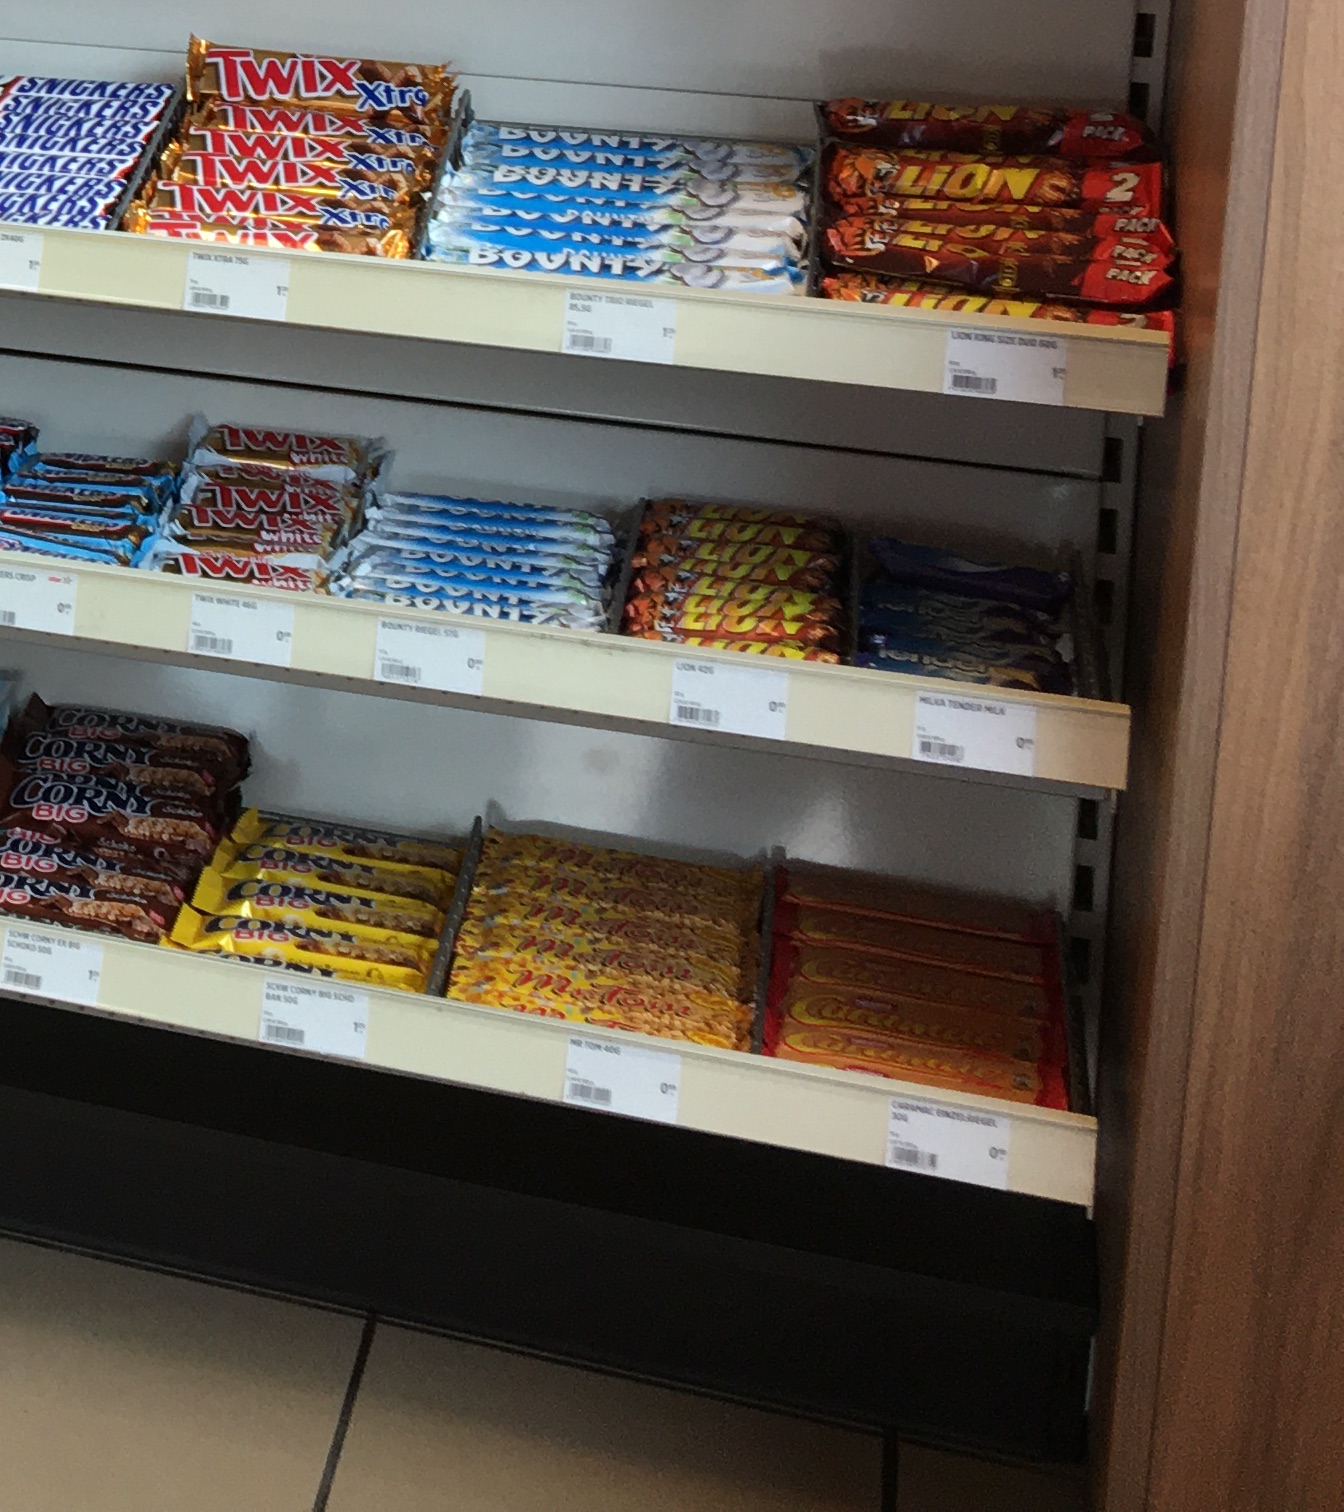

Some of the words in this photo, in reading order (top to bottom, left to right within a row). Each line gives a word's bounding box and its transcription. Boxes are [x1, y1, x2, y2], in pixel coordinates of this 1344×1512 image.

[18, 76, 173, 101] SNICKERS
[206, 47, 363, 101] TWIX
[189, 128, 352, 161] TWIX
[894, 161, 1041, 201] LION
[1109, 172, 1139, 202] 2
[468, 245, 664, 278] BOUNTY
[1105, 268, 1159, 286] PACK
[217, 424, 348, 453] TWIX
[10, 776, 152, 818] CORNY
[32, 803, 89, 824] BIG
[227, 877, 375, 910] CORNY
[253, 893, 311, 911] BIG
